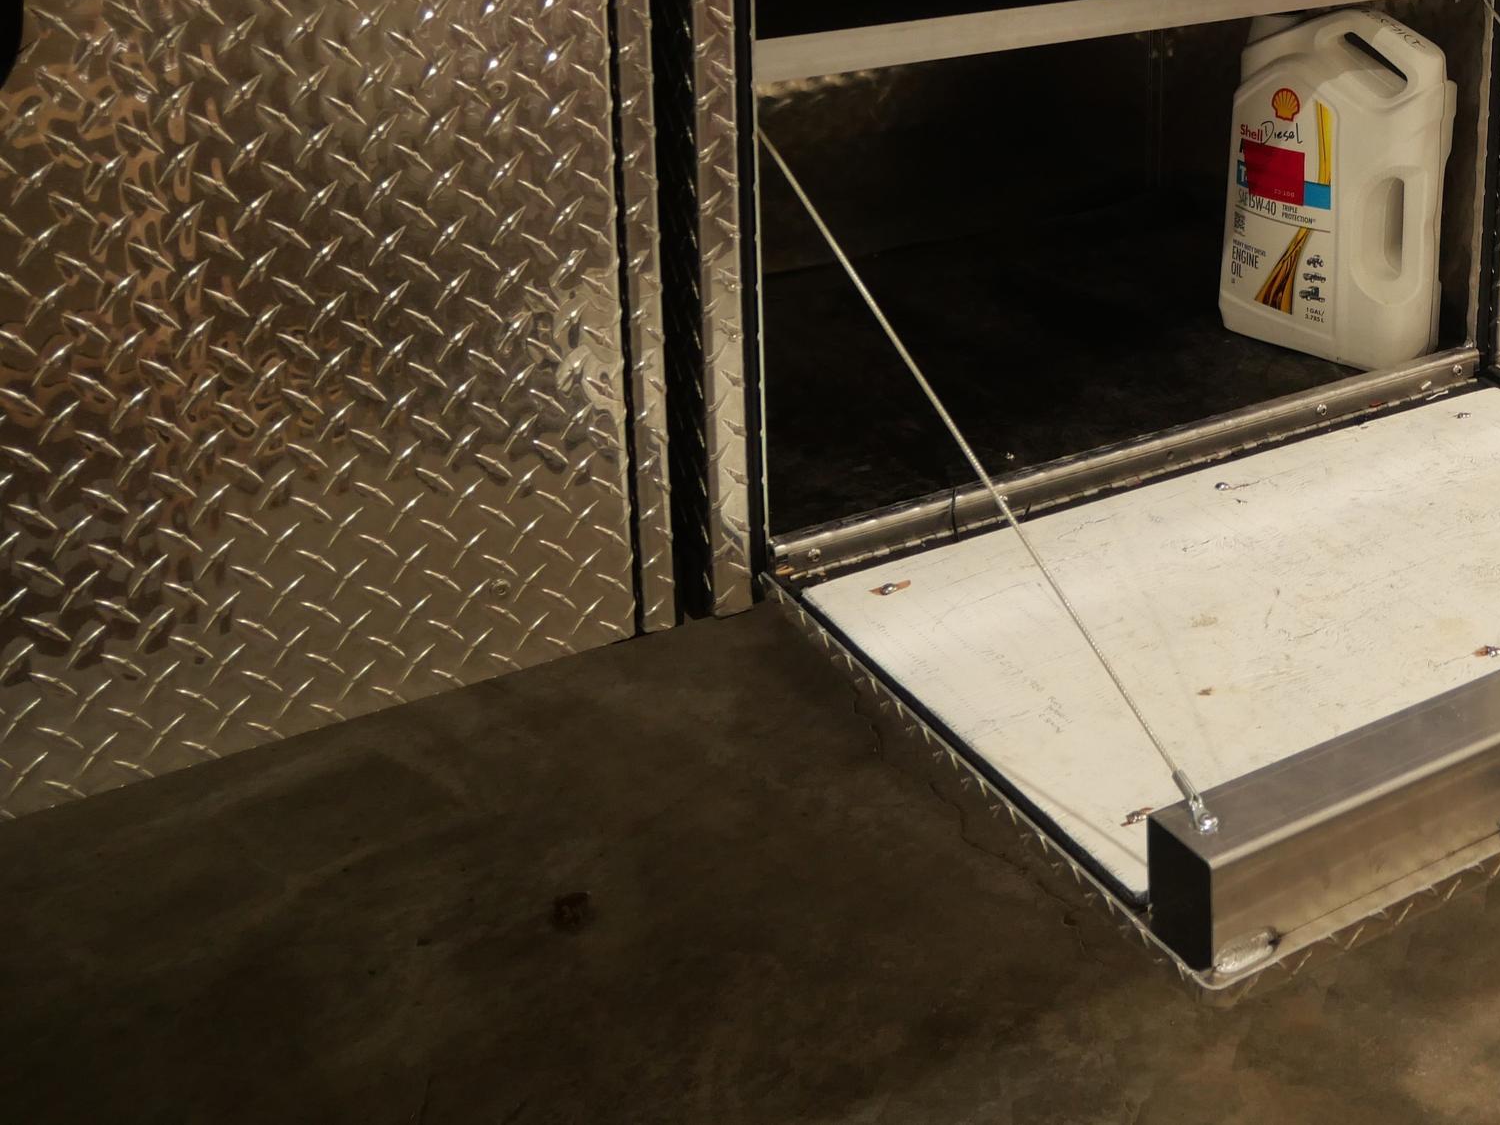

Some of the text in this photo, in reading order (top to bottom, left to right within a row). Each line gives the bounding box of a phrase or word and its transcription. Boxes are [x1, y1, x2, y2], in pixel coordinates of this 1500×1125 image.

[1240, 124, 1263, 141] Shell
[1248, 195, 1277, 216] 15W-40
[1282, 204, 1298, 214] TRIPLE
[1232, 246, 1259, 269] ENGINE
[1231, 260, 1242, 278] OIL
